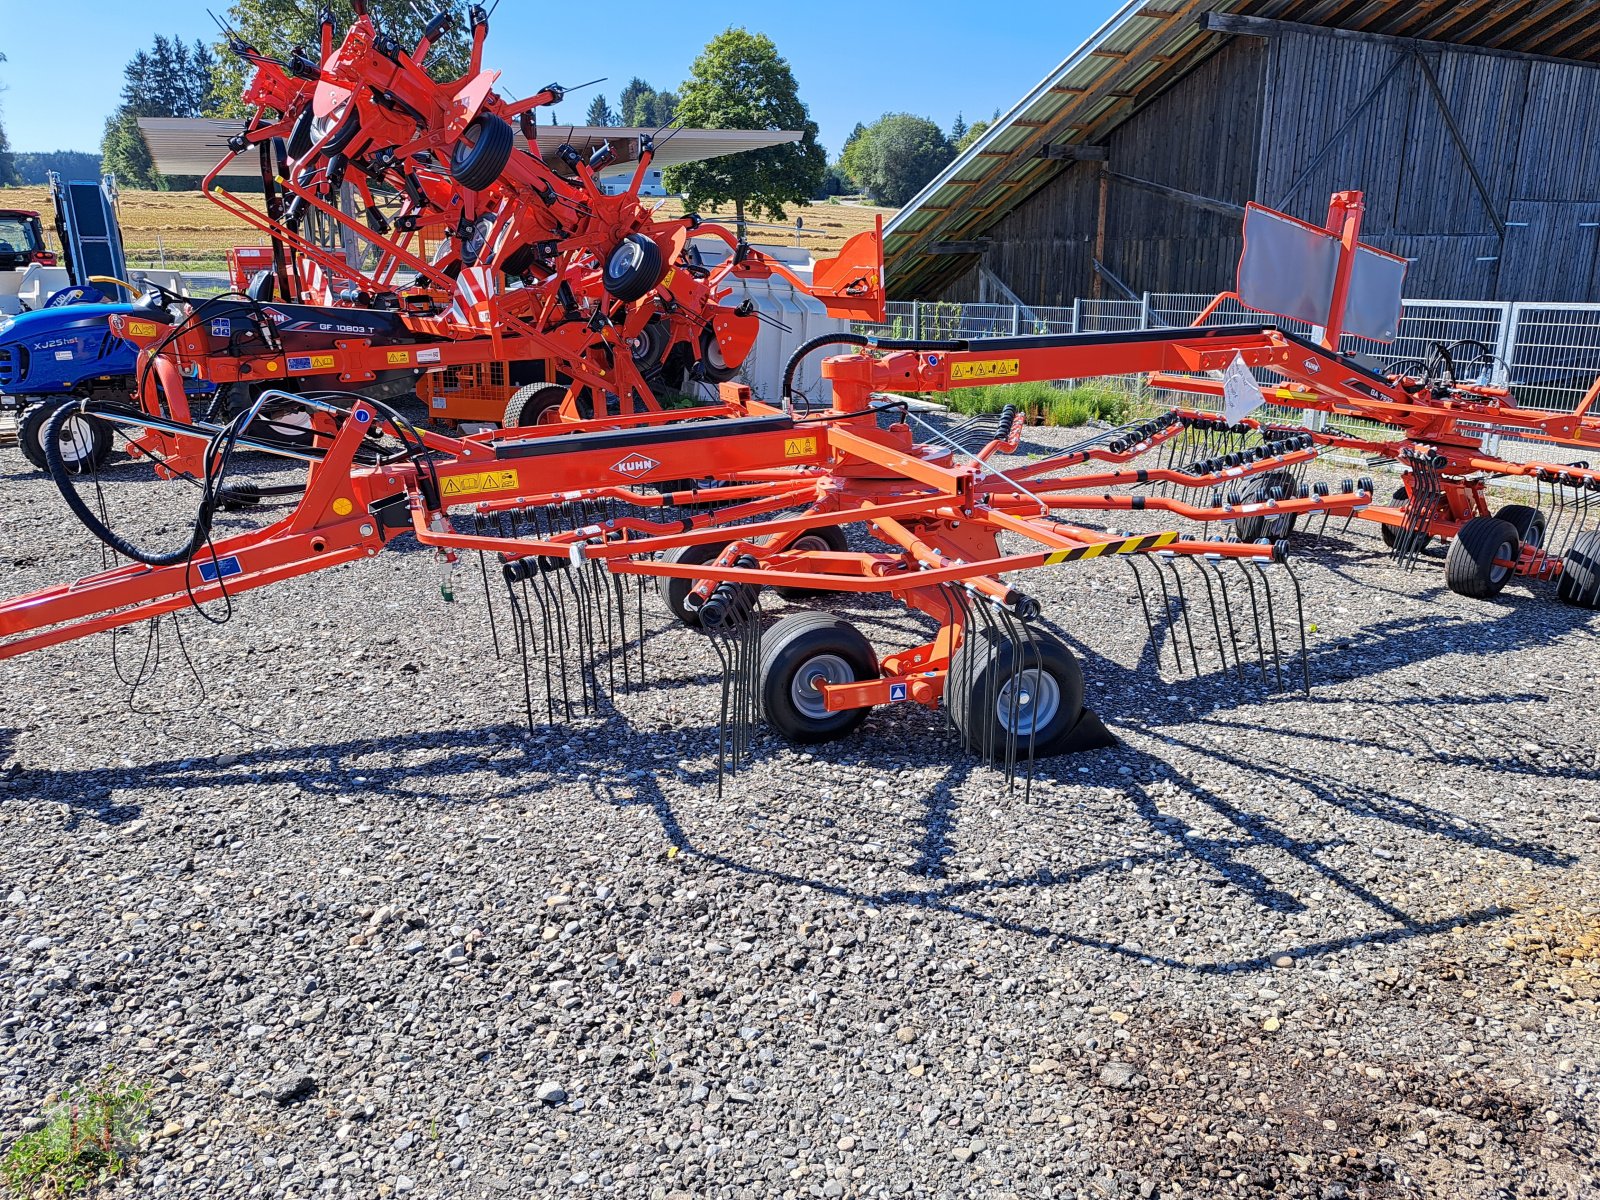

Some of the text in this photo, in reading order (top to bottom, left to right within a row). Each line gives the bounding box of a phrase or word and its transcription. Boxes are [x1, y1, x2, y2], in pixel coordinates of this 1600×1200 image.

[319, 323, 333, 331] GF
[336, 324, 365, 333] 10803
[1370, 388, 1379, 398] GA
[618, 460, 652, 472] KUHN
